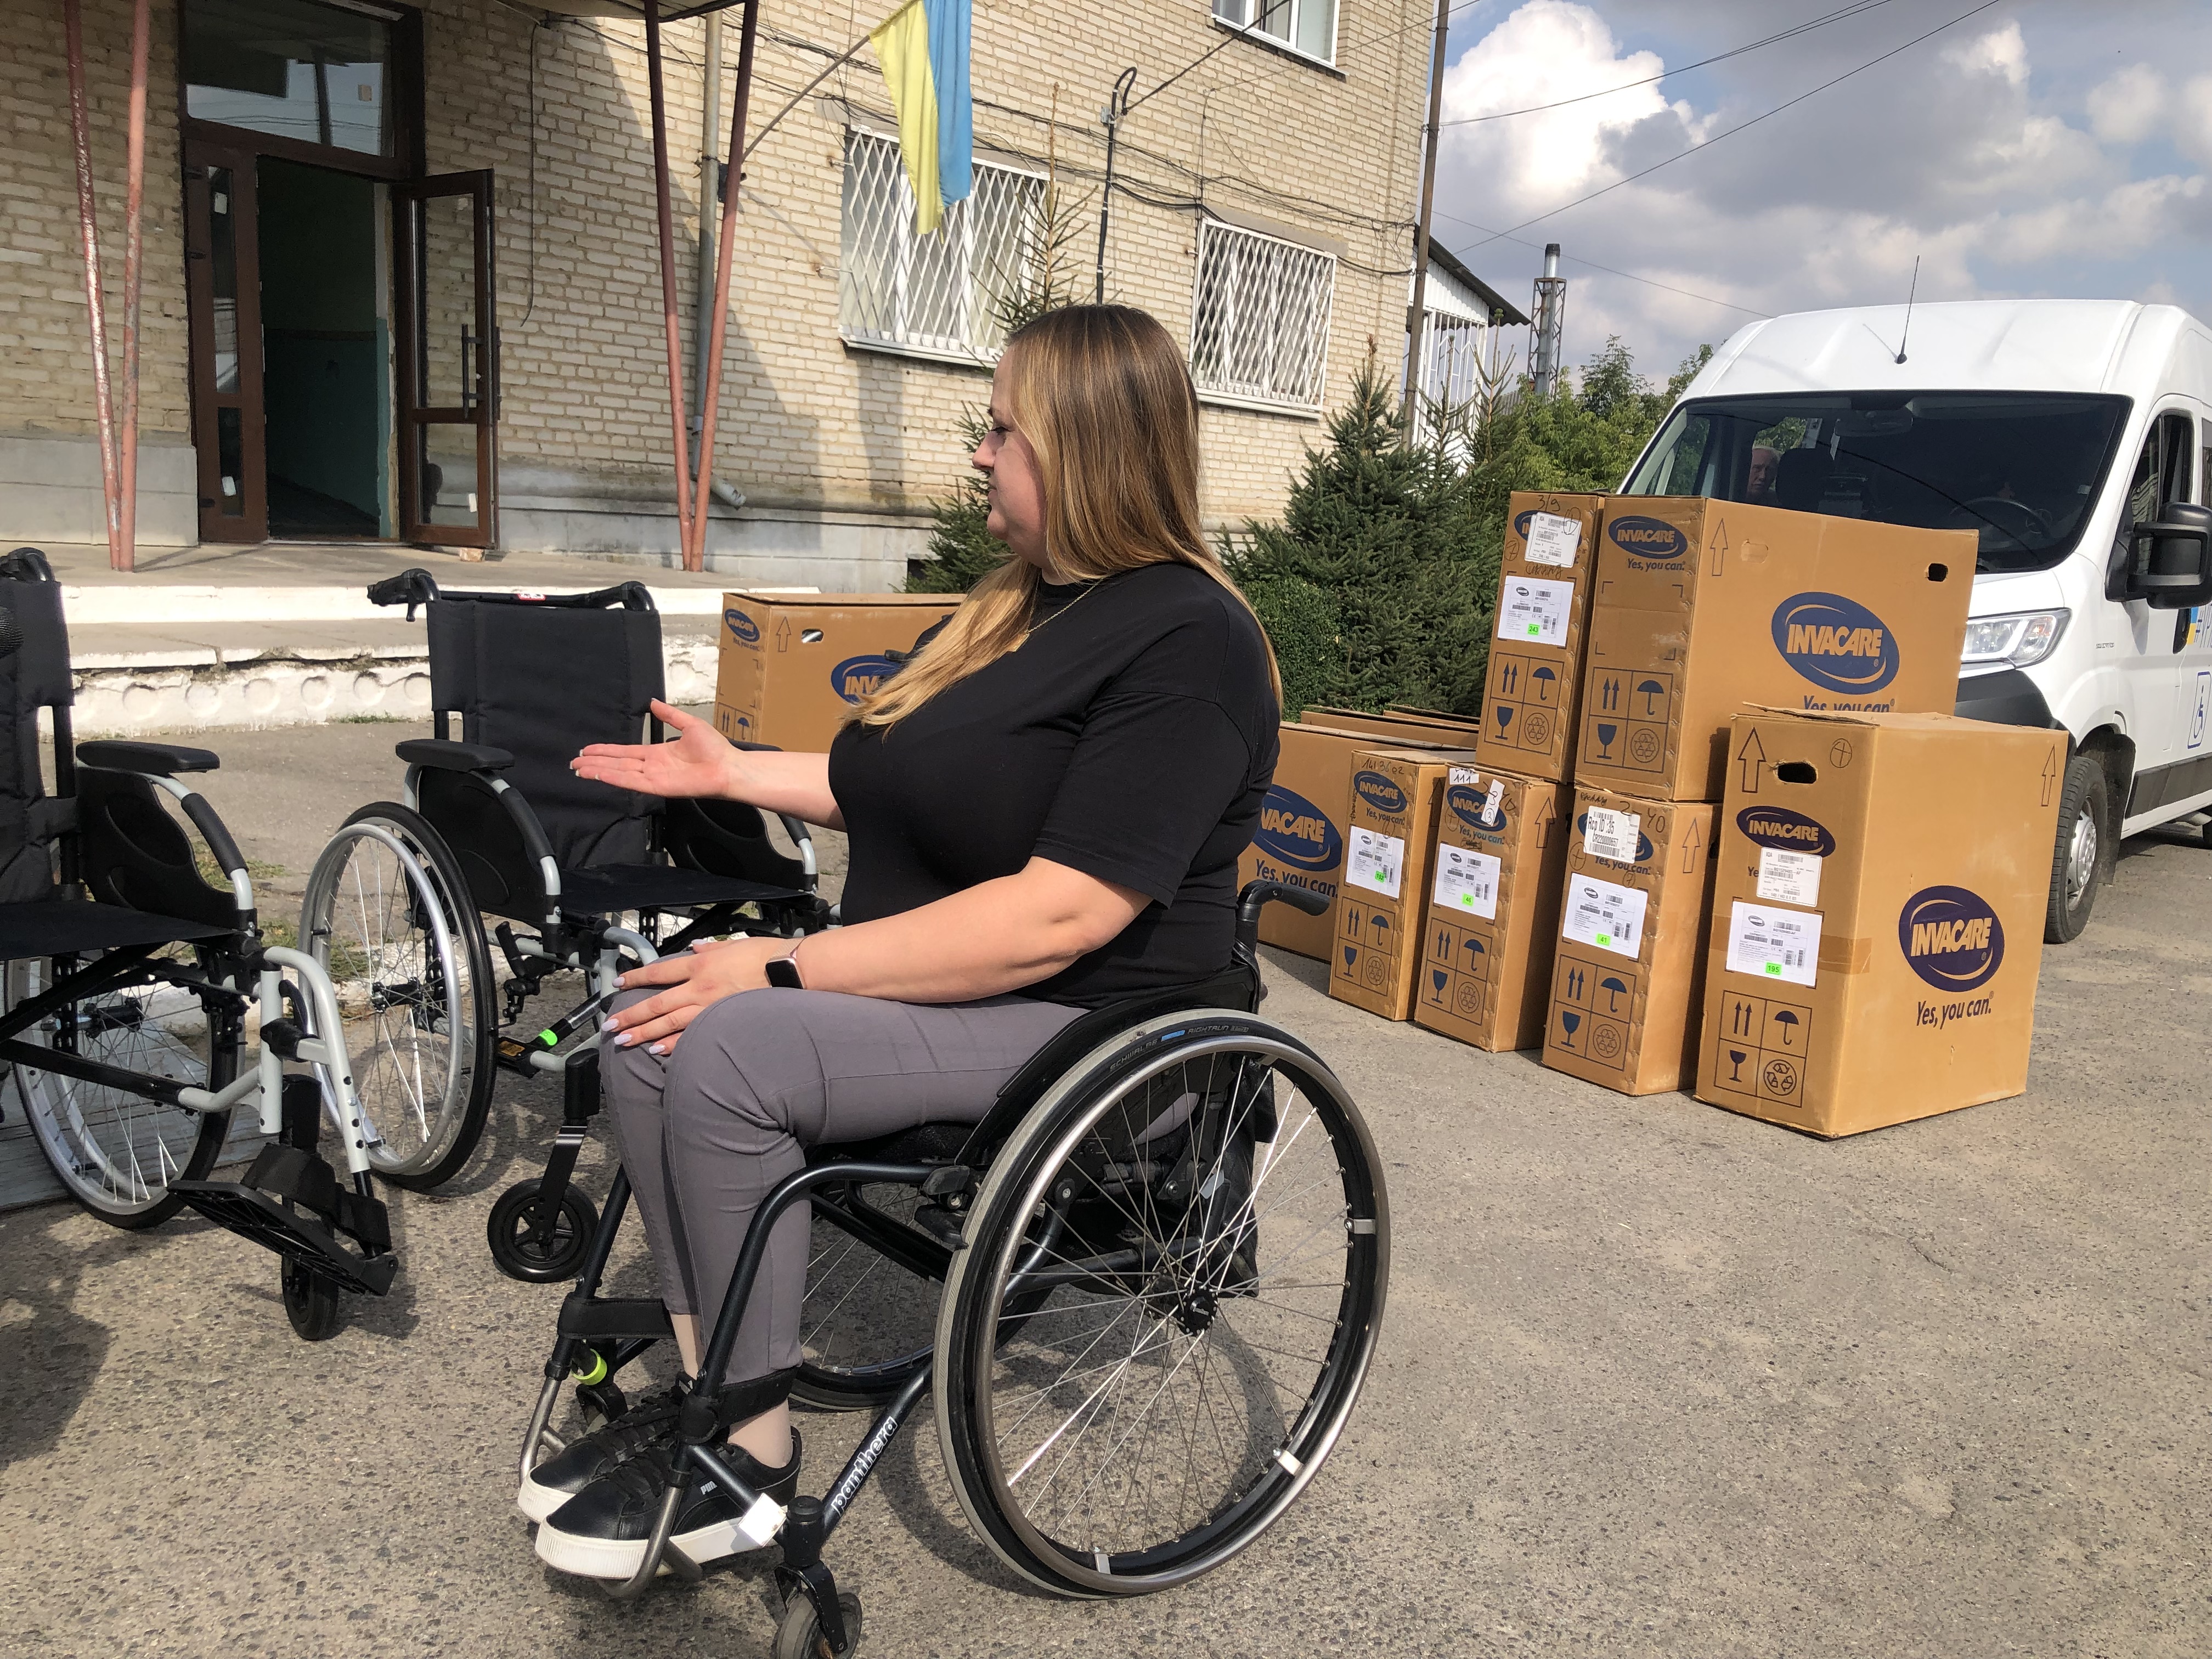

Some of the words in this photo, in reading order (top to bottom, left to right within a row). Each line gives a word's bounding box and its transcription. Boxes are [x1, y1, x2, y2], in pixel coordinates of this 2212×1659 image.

[1617, 529, 1675, 543] INVACARE
[1627, 558, 1644, 571] Yes,
[1645, 562, 1663, 572] you
[1786, 624, 1883, 657] INVACARE
[1804, 696, 1827, 710] Yes
[1864, 703, 1889, 713] can
[1359, 781, 1398, 800] INVACARE
[1366, 807, 1377, 820] Yes,
[1378, 812, 1391, 822] you
[1261, 806, 1325, 843] VACARE
[1459, 825, 1471, 837] Yes,
[1473, 831, 1487, 840] you
[1748, 820, 1819, 842] INVACARE
[1595, 856, 1611, 868] Yes,
[1612, 862, 1629, 871] you
[1748, 866, 1759, 878] Ye
[1282, 871, 1308, 889] you
[1910, 917, 1993, 957] INVACARE
[1916, 1000, 1938, 1028] Yes,
[1939, 1002, 1965, 1030] you
[1967, 998, 1991, 1017] can.
[1188, 1025, 1229, 1035] RIGHTRUN
[831, 1416, 898, 1517] panthera
[700, 1481, 717, 1496] PUM
